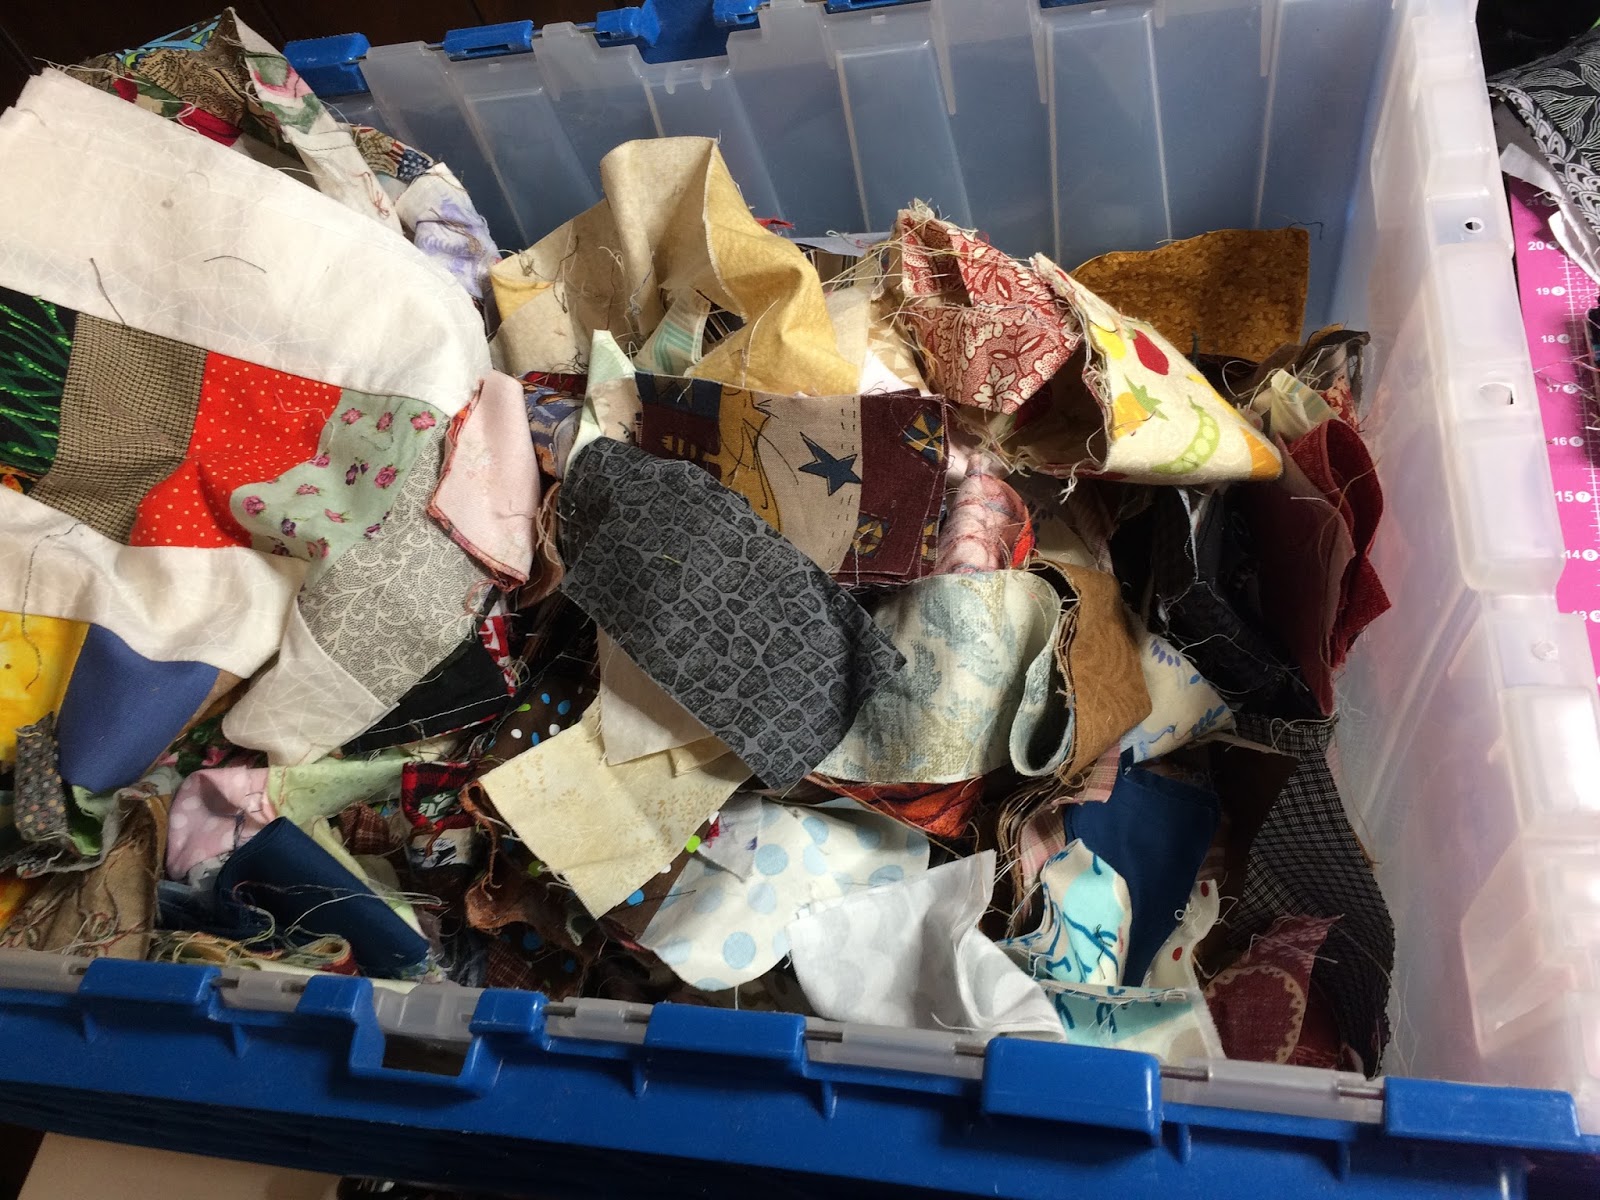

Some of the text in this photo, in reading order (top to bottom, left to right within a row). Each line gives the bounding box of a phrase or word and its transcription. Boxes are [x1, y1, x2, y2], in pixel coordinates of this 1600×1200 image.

[1526, 240, 1545, 251] 20
[1536, 286, 1550, 296] 19
[1541, 334, 1555, 343] 18
[1547, 384, 1561, 393] 17
[1552, 436, 1568, 446] 16
[1555, 491, 1574, 503] 15
[1564, 549, 1580, 560] 14
